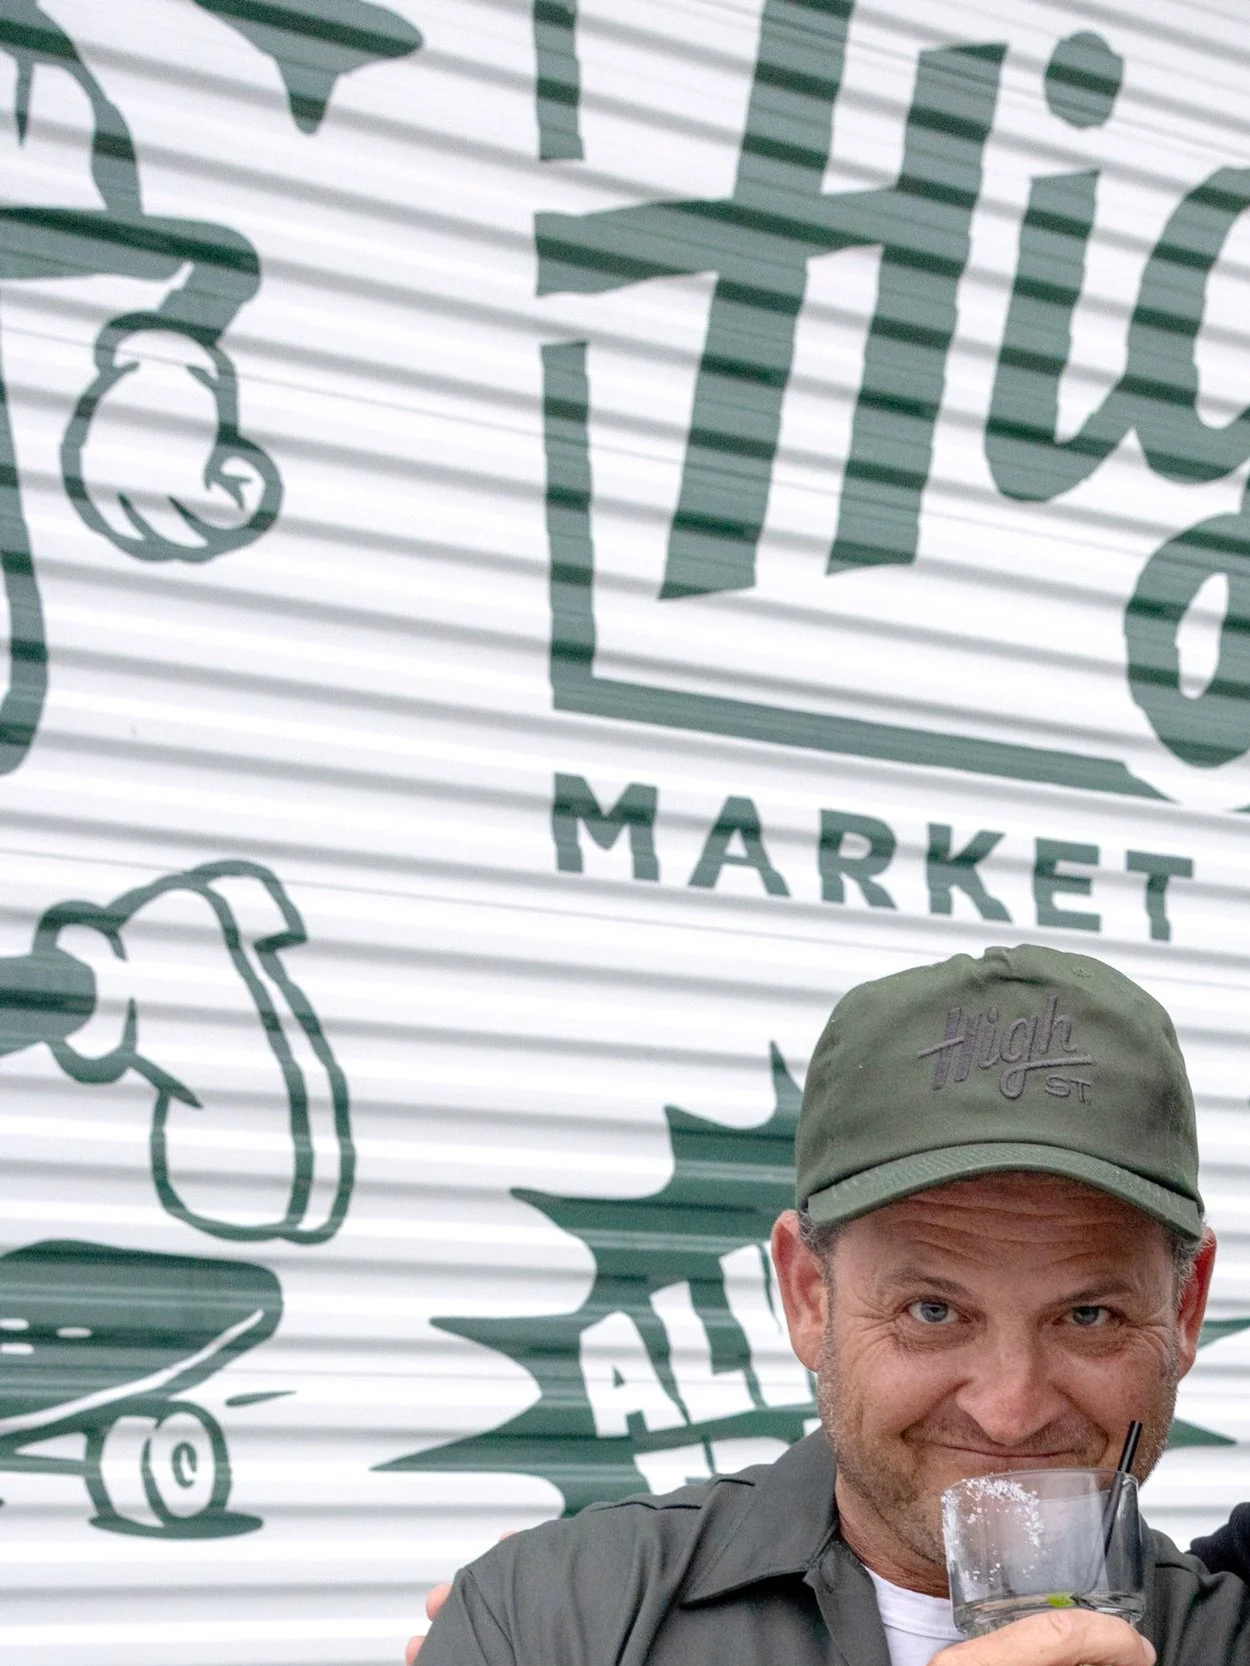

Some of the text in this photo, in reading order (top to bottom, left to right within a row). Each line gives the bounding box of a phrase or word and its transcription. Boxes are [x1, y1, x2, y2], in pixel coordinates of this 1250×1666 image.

[552, 771, 1194, 943] MARKET
[917, 996, 1092, 1100] High
[1045, 1075, 1093, 1105] ST
